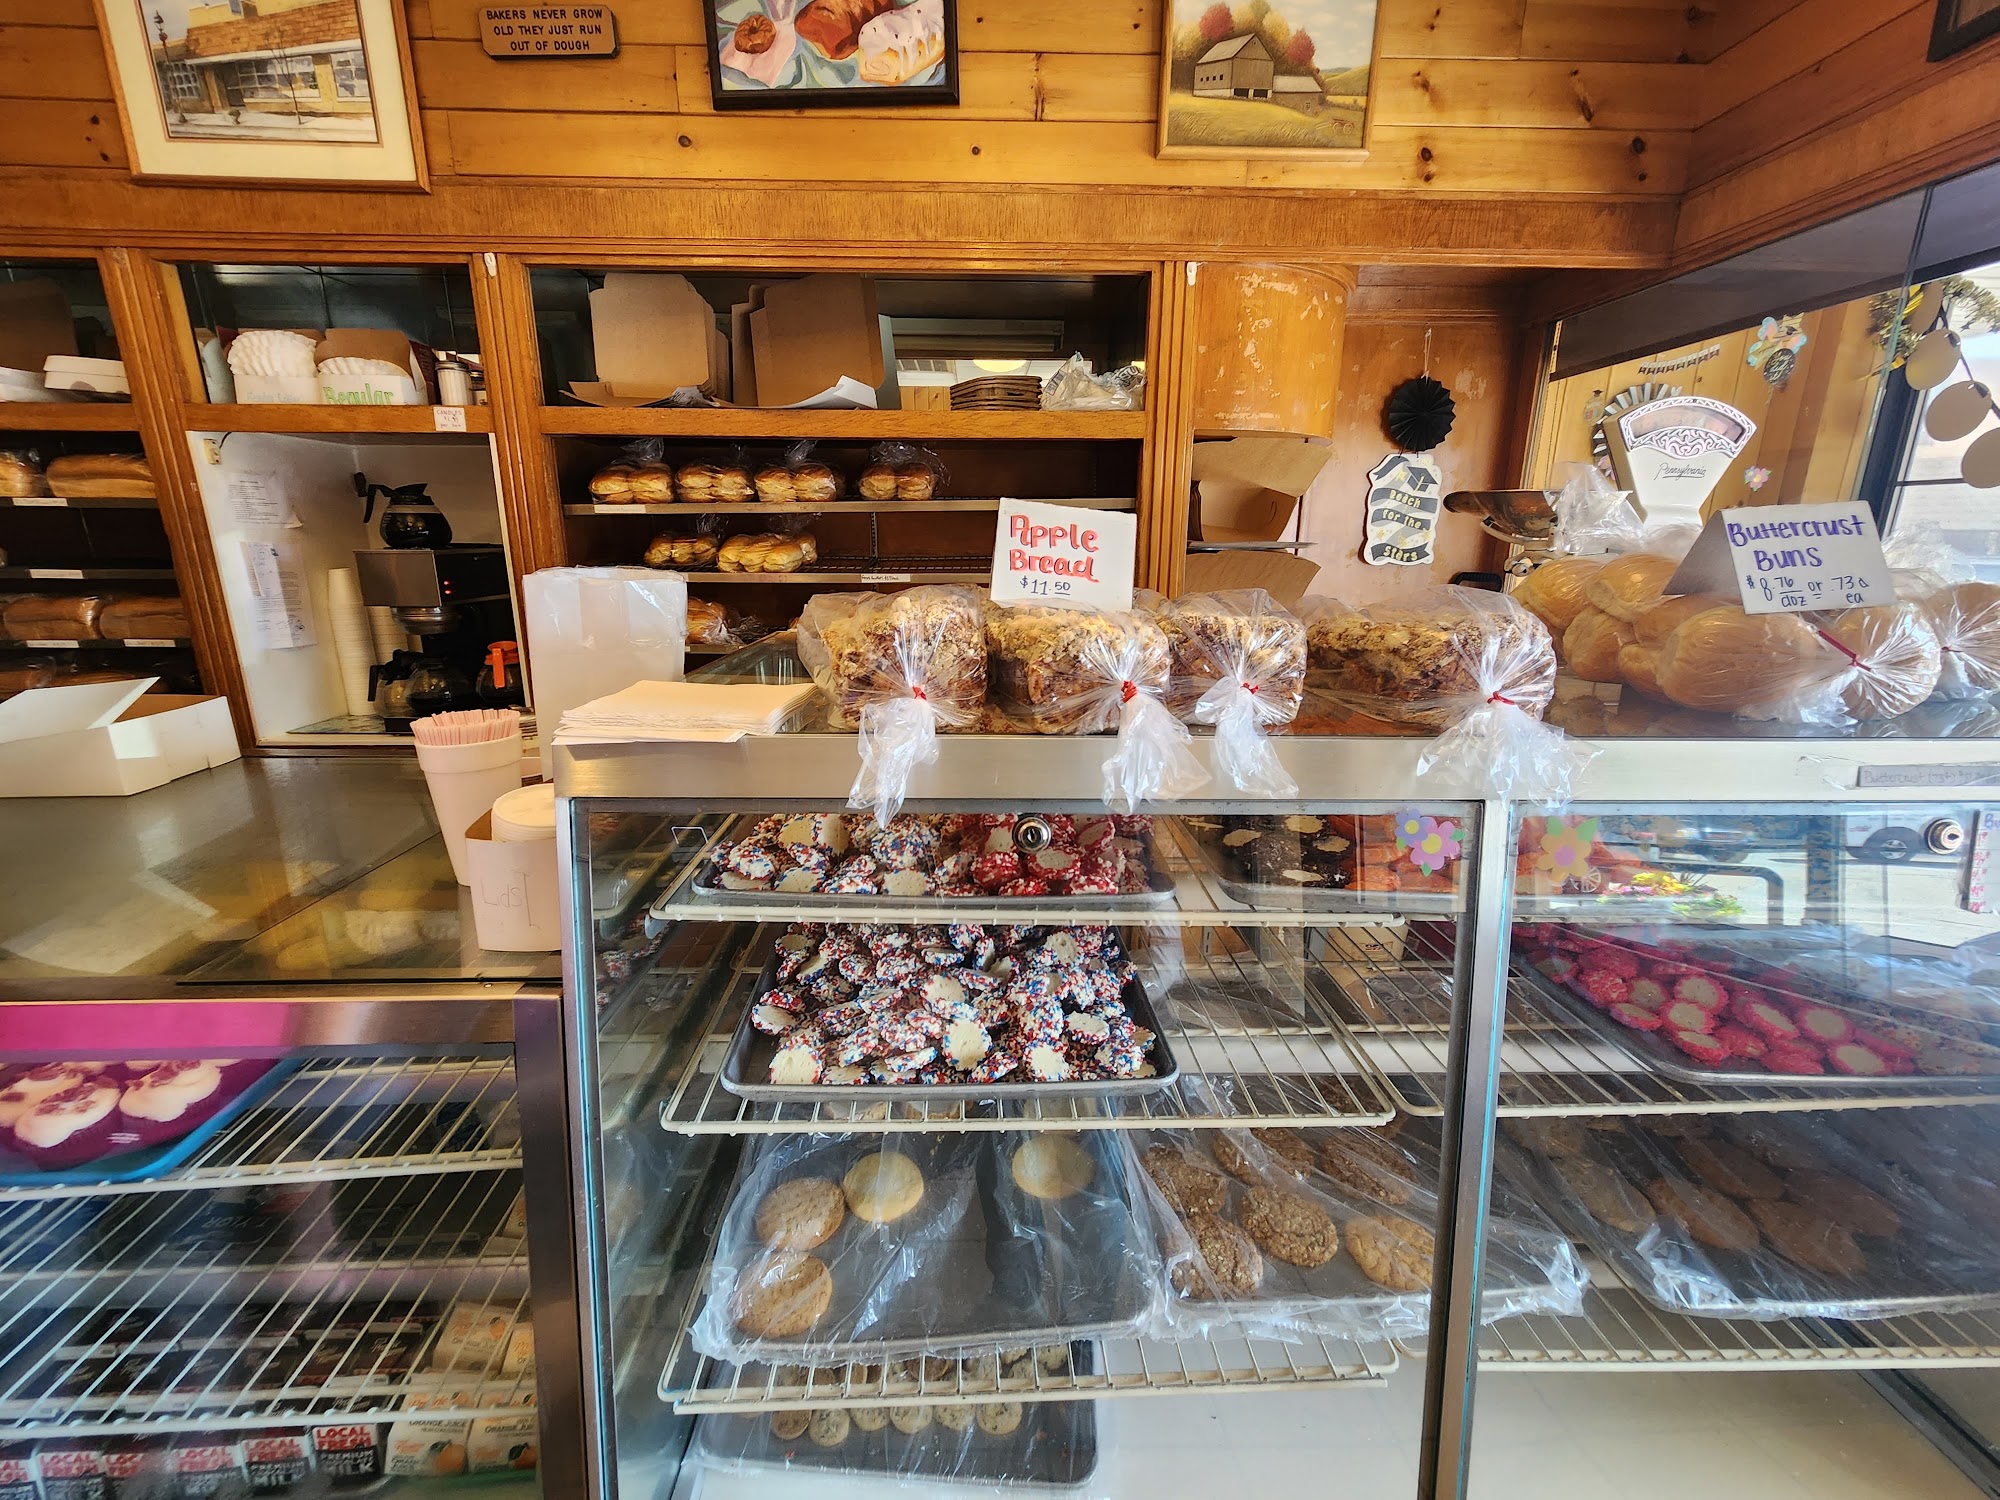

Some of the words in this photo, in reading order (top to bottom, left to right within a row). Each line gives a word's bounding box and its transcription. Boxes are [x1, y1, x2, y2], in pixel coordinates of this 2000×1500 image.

[486, 10, 526, 20] BAKERS
[532, 9, 566, 19] NEVER
[573, 9, 603, 18] GROW
[493, 26, 513, 35] OLD
[518, 25, 544, 35] THEY
[548, 25, 573, 34] JUST
[579, 25, 602, 34] RUN
[510, 41, 530, 51] OUT
[535, 41, 549, 51] OF
[554, 41, 590, 50] DOUGH
[323, 383, 394, 405] Regular
[1654, 462, 1707, 481] Pennsylvania
[1389, 489, 1421, 508] Reach
[1382, 509, 1401, 521] for
[1404, 517, 1422, 529] the
[1009, 514, 1099, 552] Apple
[1727, 514, 1865, 547] Buttercrust
[1009, 549, 1099, 583] Bread
[1753, 546, 1823, 572] Buns
[1019, 575, 1071, 596] $11.50
[1781, 593, 1808, 608] doz
[1846, 592, 1865, 604] ea
[317, 1425, 370, 1439] LOCAL
[317, 1437, 372, 1452] FRESH
